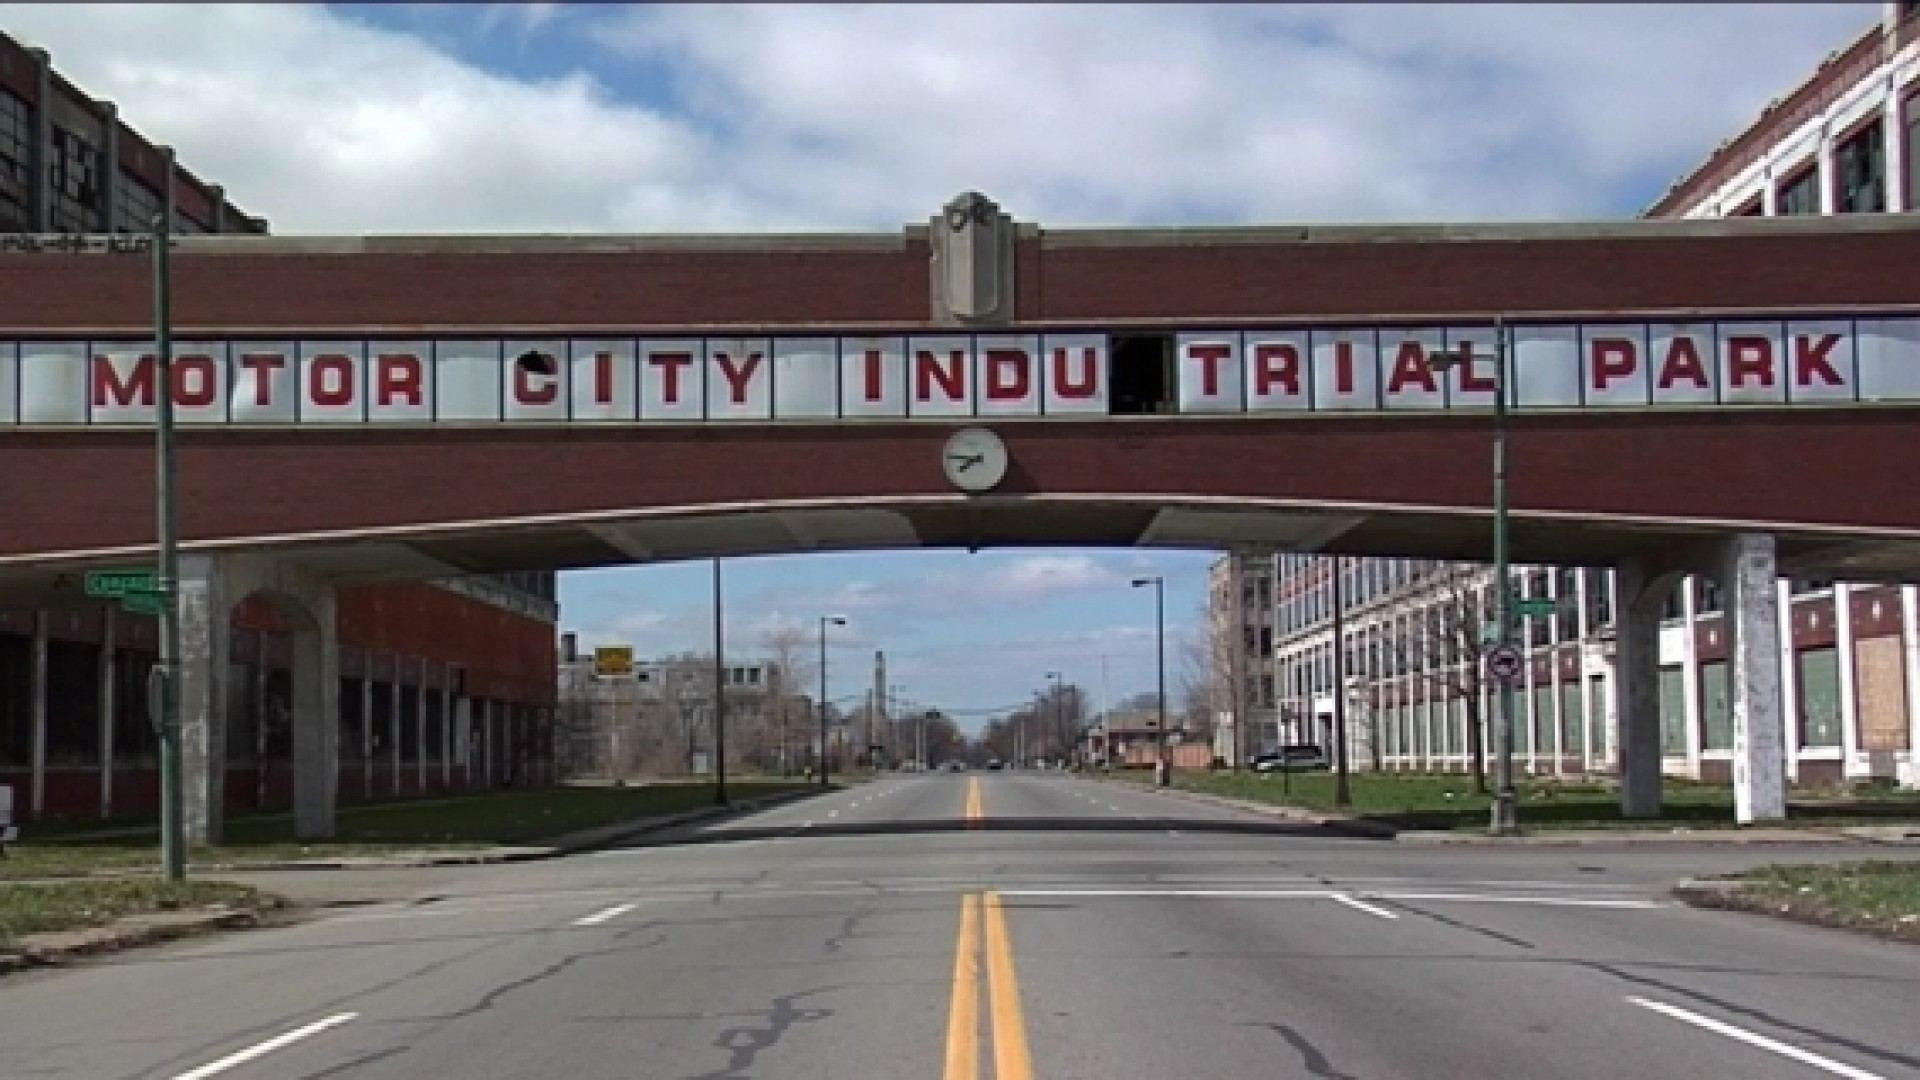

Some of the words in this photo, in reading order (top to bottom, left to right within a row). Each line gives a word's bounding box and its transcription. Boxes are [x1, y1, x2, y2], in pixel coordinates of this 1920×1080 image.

[93, 354, 422, 407] MOTOR
[513, 351, 764, 405] CITY
[1591, 333, 1846, 389] PARK
